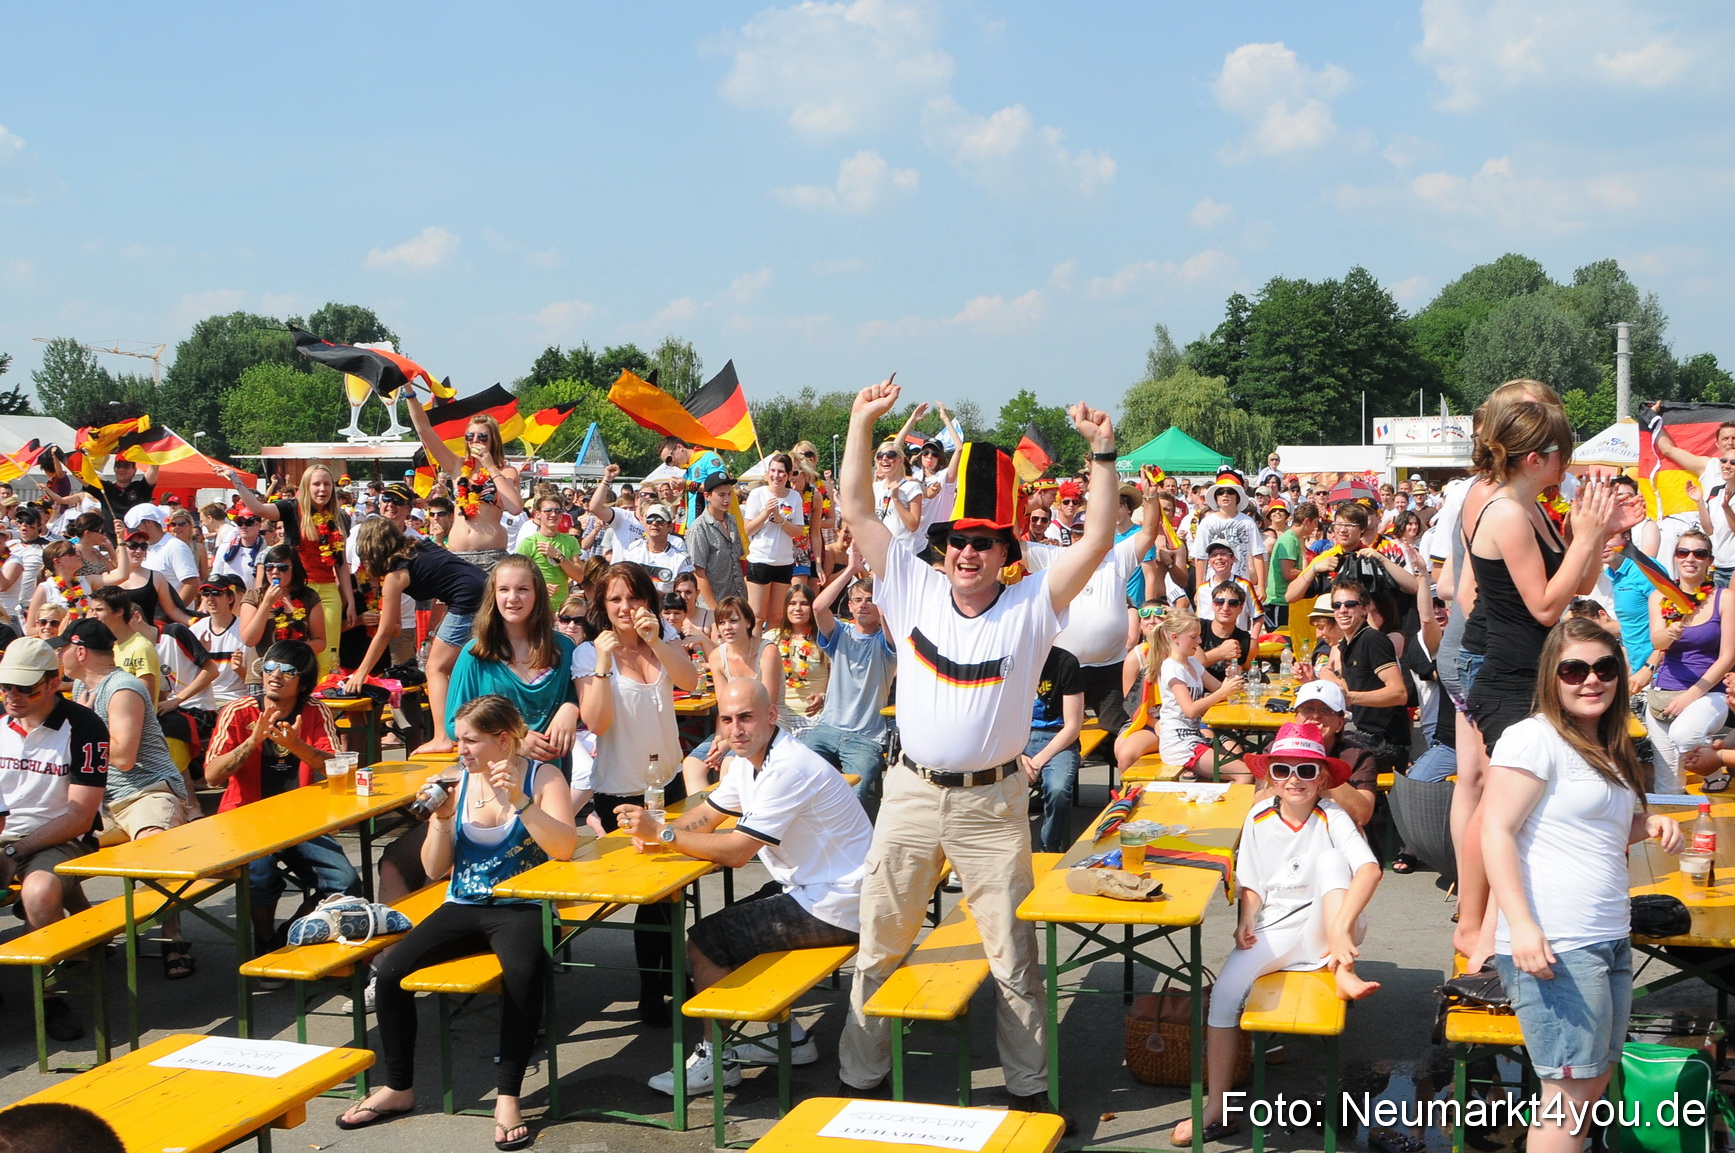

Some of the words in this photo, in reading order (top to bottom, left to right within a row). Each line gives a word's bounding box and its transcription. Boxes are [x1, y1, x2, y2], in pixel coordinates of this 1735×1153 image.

[1115, 459, 1134, 468] AOK
[81, 742, 109, 774] 13
[174, 1057, 276, 1072] RESERVIERT
[840, 1127, 966, 1143] RESERVIERT
